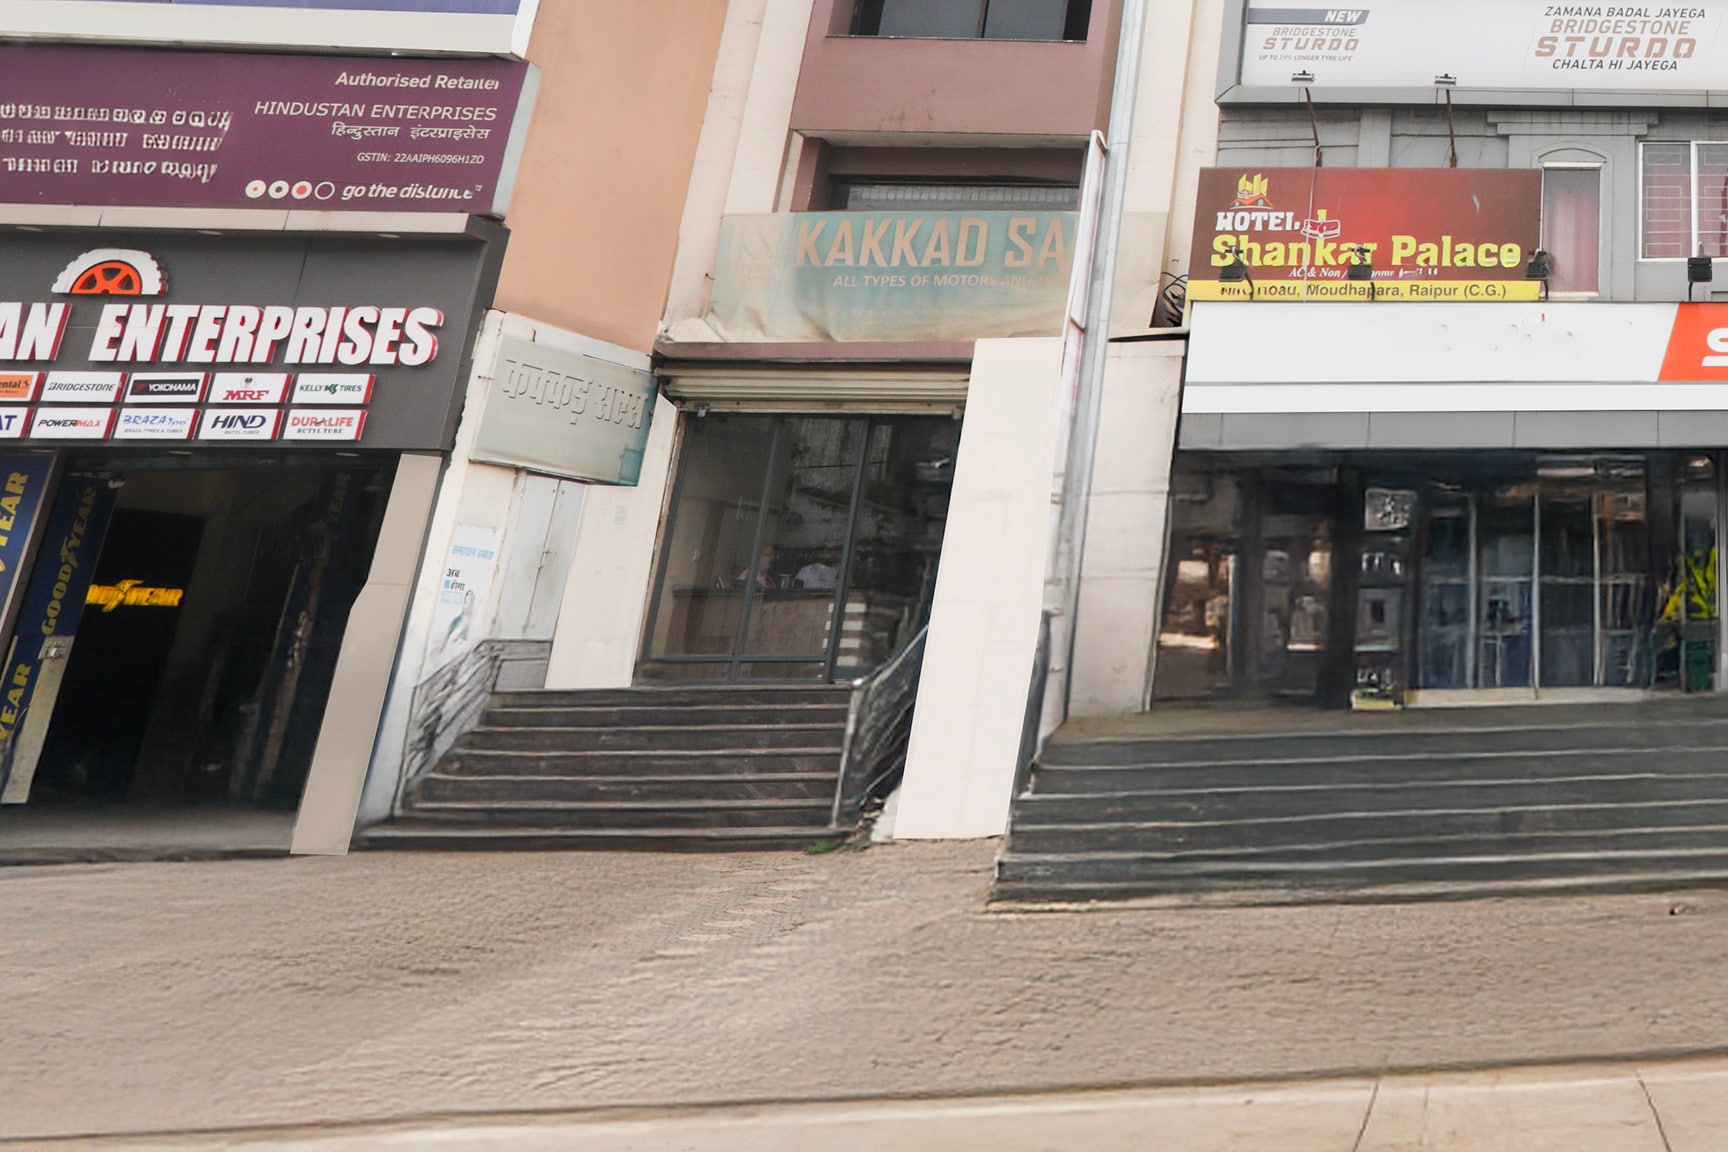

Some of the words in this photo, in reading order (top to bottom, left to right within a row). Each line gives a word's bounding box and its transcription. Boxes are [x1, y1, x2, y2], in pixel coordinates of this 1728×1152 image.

[1324, 10, 1361, 23] NEW
[1544, 6, 1602, 17] ZAMANA
[1606, 7, 1650, 18] BADAL
[1655, 8, 1706, 19] JAYEGA
[1272, 27, 1357, 37] BRIDGESTONE
[1550, 19, 1692, 35] BRIDGESTONE
[1263, 37, 1359, 51] STURDO
[1535, 36, 1697, 59] STURDO
[1552, 59, 1604, 70] CHALTA
[1608, 60, 1623, 70] HI
[1626, 60, 1678, 71] JAYEGA
[334, 72, 430, 89] Authorised
[254, 100, 365, 118] HINDUSTAN
[370, 103, 497, 121] ENTERPRISES
[331, 121, 400, 140] हिन्दुस्तान
[410, 123, 491, 141] इंटरप्राइसेस
[356, 152, 391, 163] GSTIN:
[341, 184, 367, 200] go
[368, 182, 397, 198] the
[1215, 211, 1300, 231] HOTEL
[796, 217, 989, 267] KAKKAD
[1210, 219, 1377, 267] Shankar
[1391, 235, 1521, 268] Palace
[1289, 266, 1306, 278] AC
[1307, 267, 1316, 278] &
[1320, 267, 1340, 278] Non
[833, 274, 858, 288] ALL
[863, 274, 906, 288] TYPES
[910, 275, 930, 288] OF
[933, 275, 998, 288] MOTORS
[1409, 284, 1458, 298] Raipur
[1464, 284, 1507, 298] (C.G.)
[89, 304, 444, 367] ENTERPRISES
[48, 381, 116, 392] BRIDGESTONE
[149, 383, 197, 392] YOKOHAMA
[300, 384, 323, 392] KELLY
[340, 384, 362, 392] TIRES
[223, 390, 269, 401] MRF
[37, 419, 103, 428] POWERMAX
[123, 414, 166, 425] BRAZA
[211, 415, 267, 429] HIND
[291, 416, 354, 427] DURALIFE
[41, 487, 97, 636] GOODYEAR
